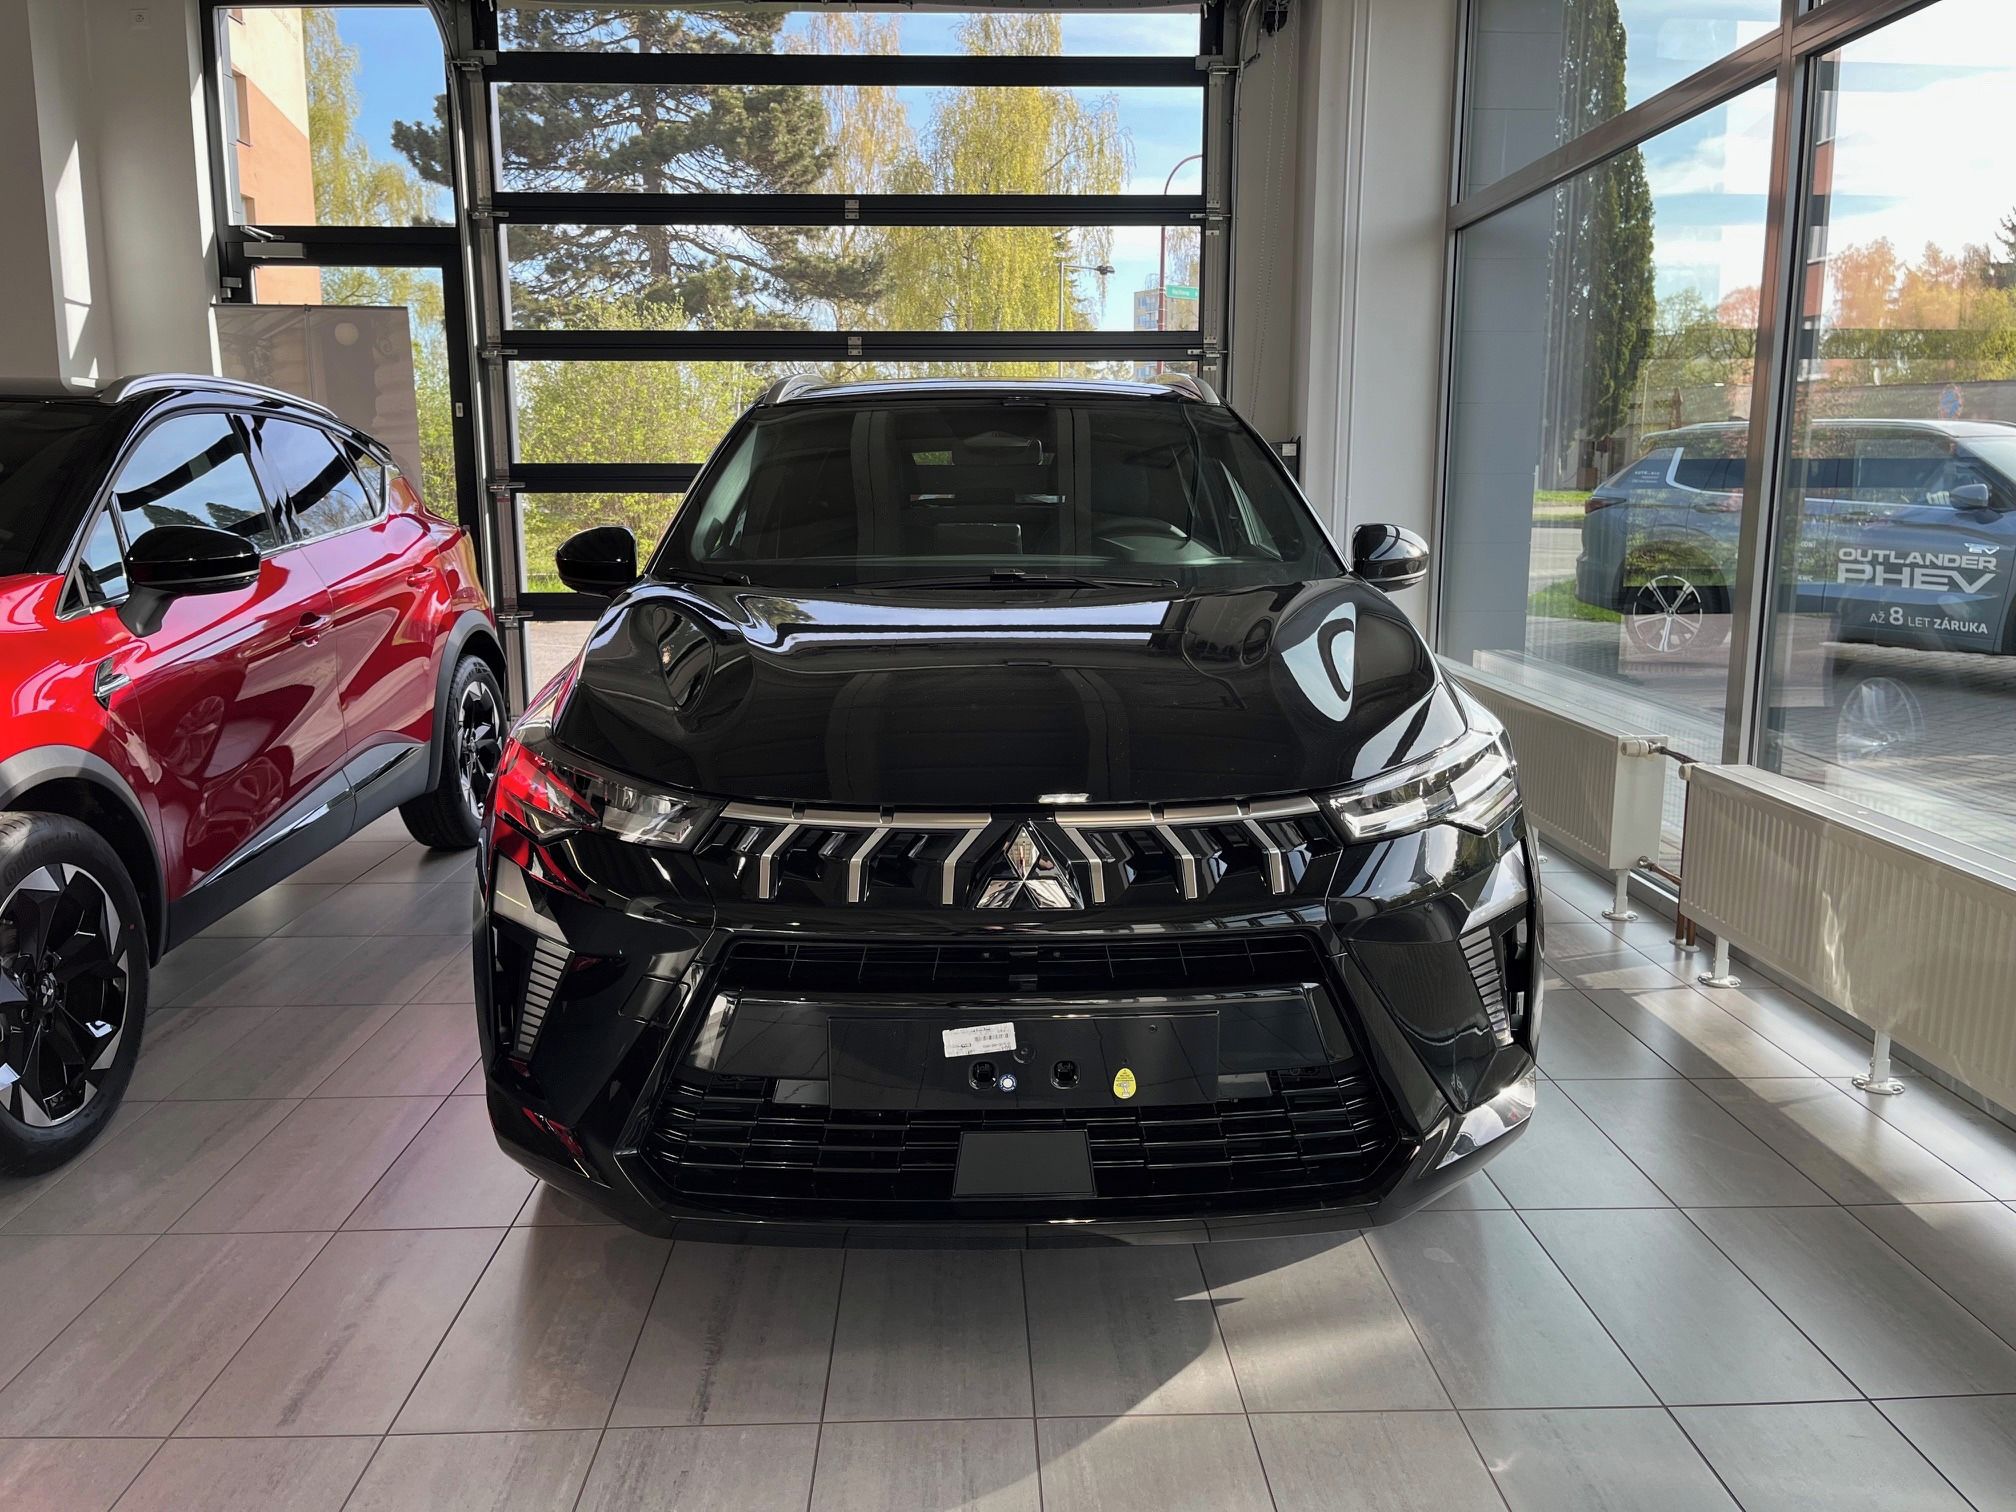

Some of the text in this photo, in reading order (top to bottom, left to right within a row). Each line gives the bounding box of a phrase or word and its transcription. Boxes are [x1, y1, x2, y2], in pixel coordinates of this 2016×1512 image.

[1838, 548, 1997, 571] OUTLANDER
[1837, 563, 1996, 594] PHEV
[1869, 606, 1988, 635] AŽ 8 LET ZÁRUKA
